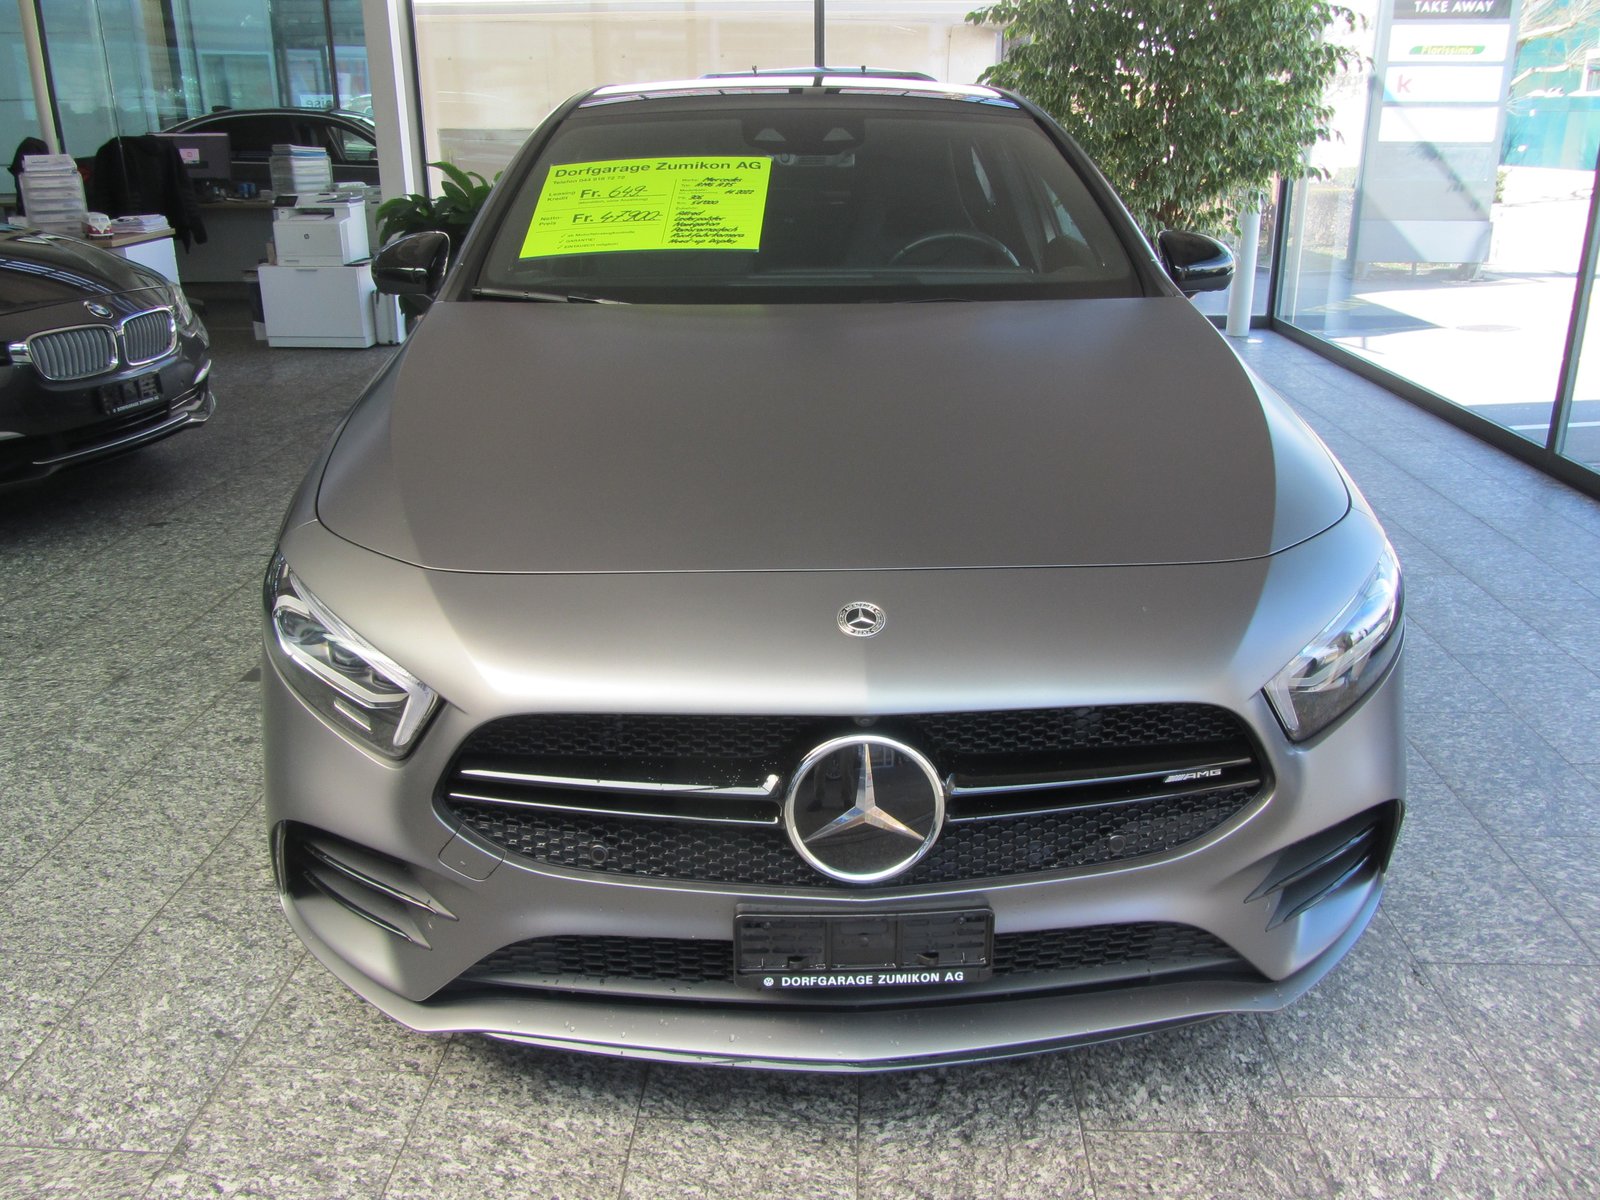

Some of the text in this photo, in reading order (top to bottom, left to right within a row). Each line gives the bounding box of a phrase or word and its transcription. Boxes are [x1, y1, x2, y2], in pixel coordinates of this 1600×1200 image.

[1414, 0, 1494, 13] TAKE AWAY
[555, 161, 761, 177] Dorfgarage Zumikon AG
[580, 189, 601, 198] Fr.
[572, 213, 594, 223] Fr.
[1179, 769, 1222, 781] AMG
[781, 971, 964, 987] DORFGARAGE ZUMIKON AG
